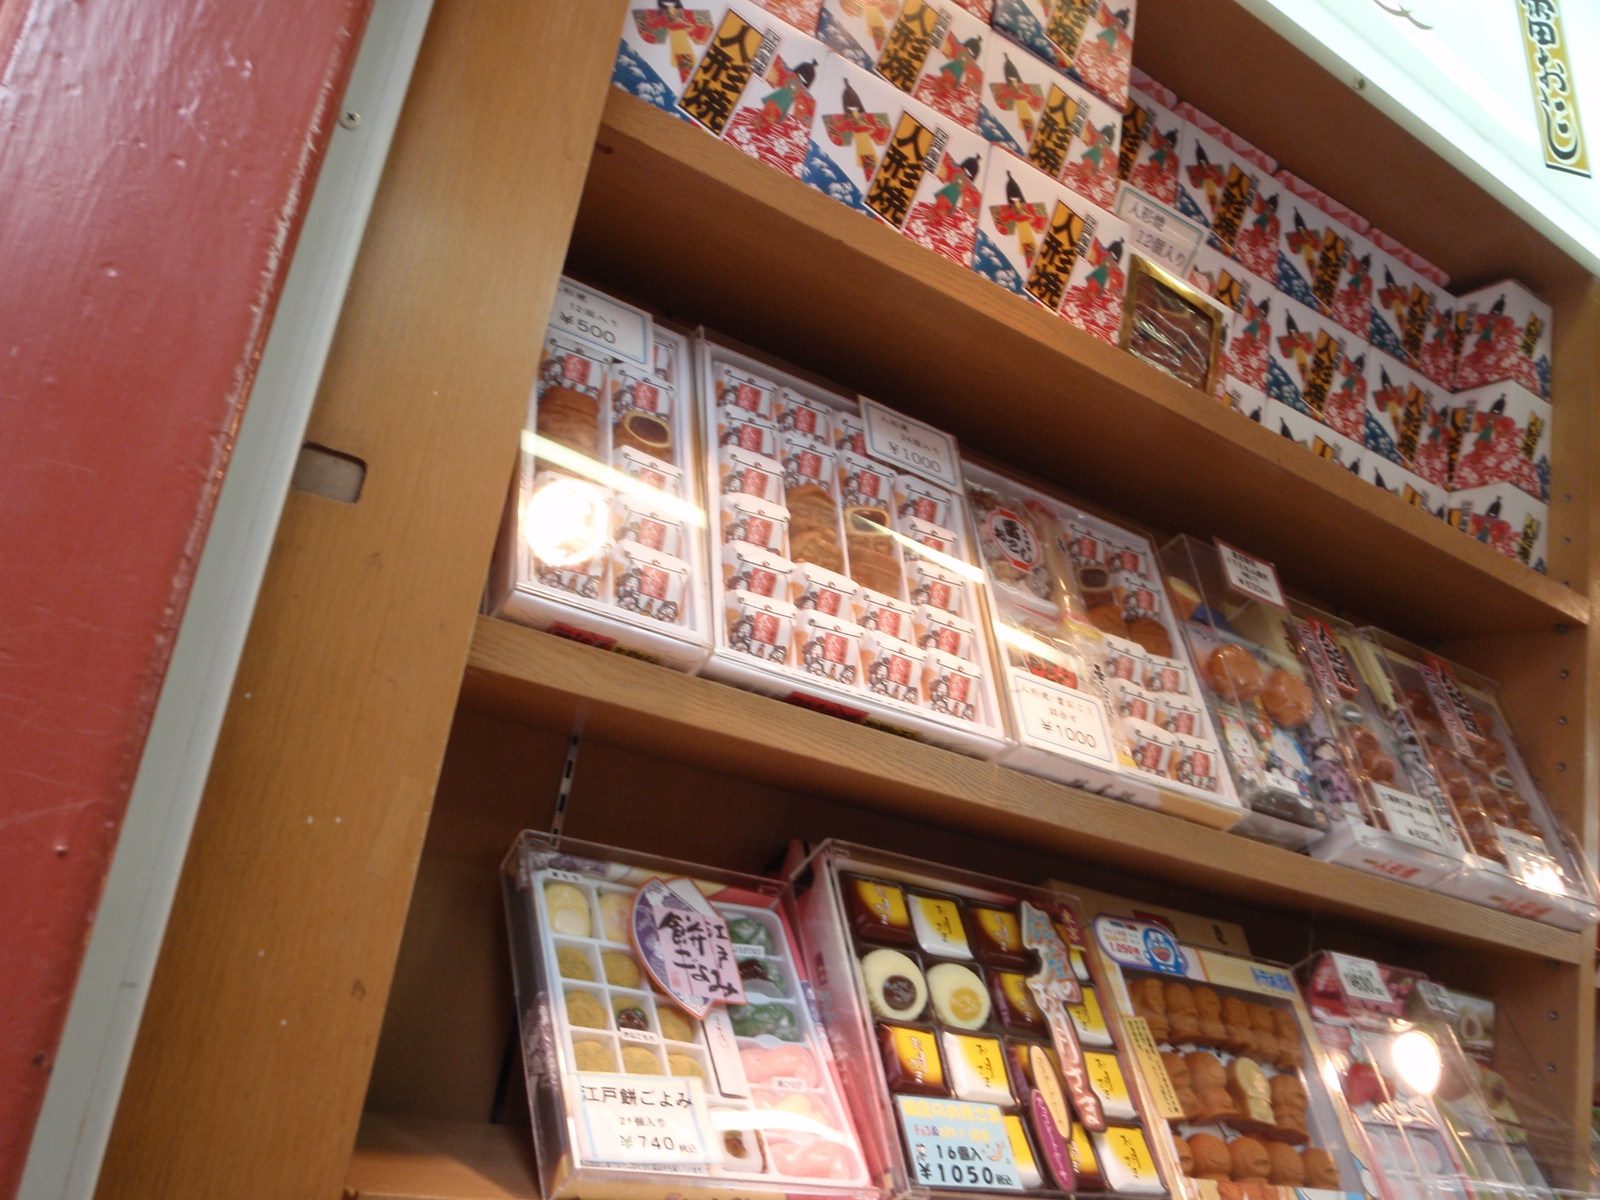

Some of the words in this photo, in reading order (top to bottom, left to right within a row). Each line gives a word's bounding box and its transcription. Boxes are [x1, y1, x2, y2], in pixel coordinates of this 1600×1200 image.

[559, 311, 617, 344] ¥500
[581, 1085, 693, 1108] 江戸餅こよみ
[619, 1135, 675, 1151] ¥740
[918, 1162, 994, 1185] ¥1050
